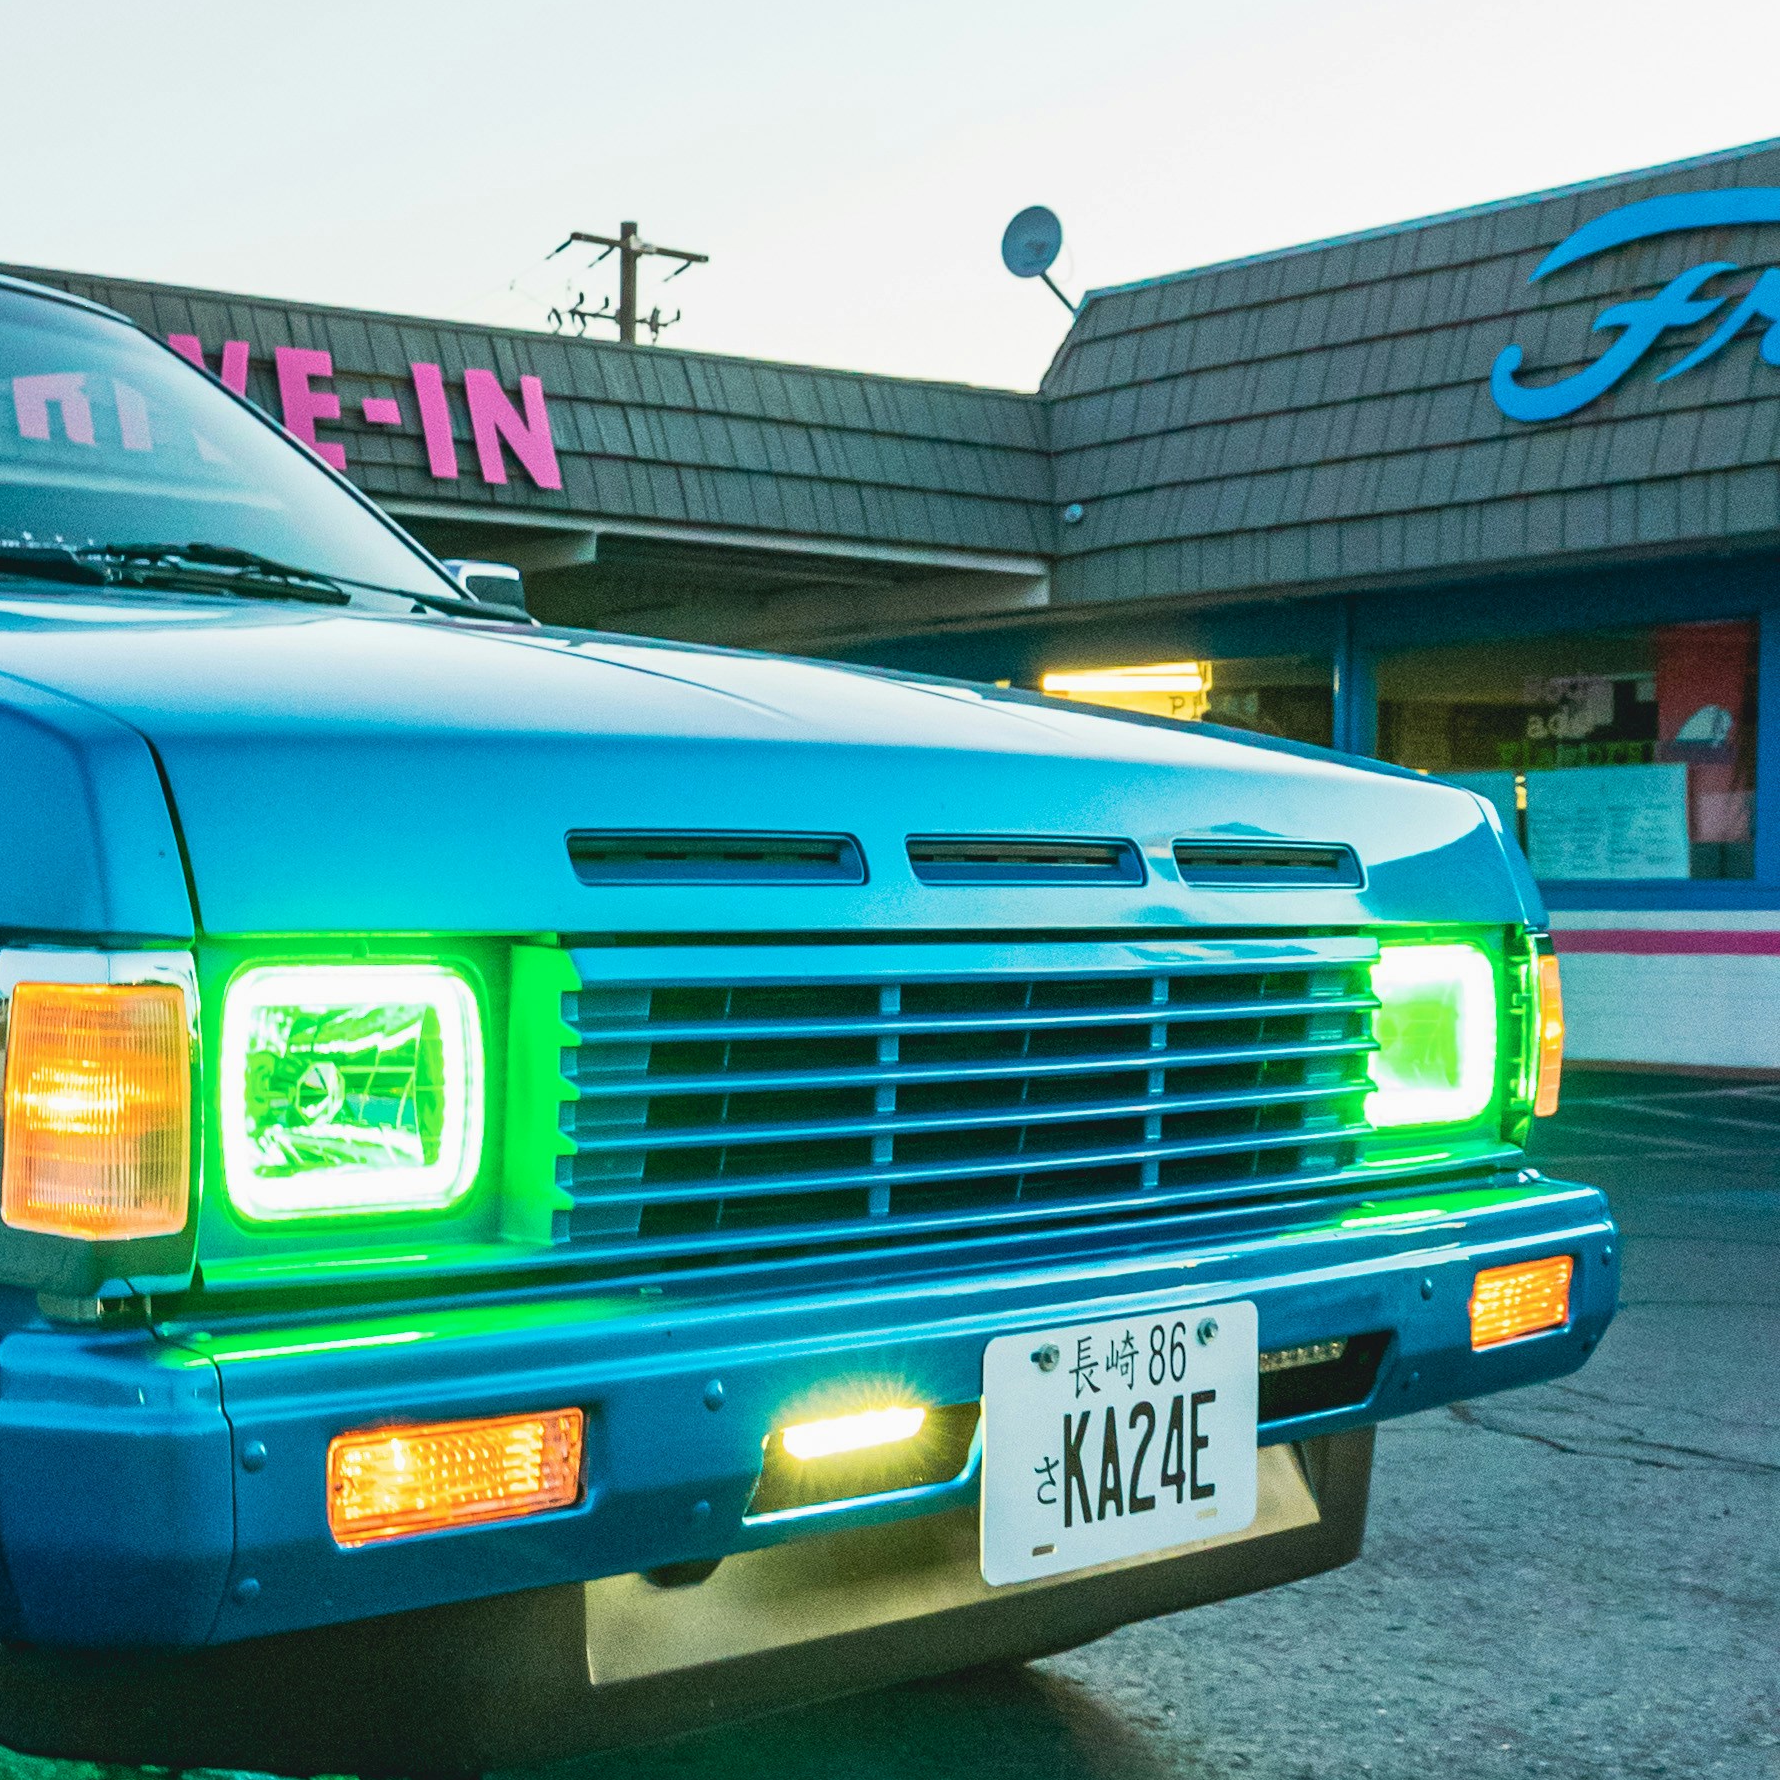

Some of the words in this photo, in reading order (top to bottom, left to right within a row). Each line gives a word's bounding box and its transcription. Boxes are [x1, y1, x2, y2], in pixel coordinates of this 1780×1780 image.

[1068, 1329, 1140, 1399] 長崎
[1148, 1321, 1187, 1386] 86
[1034, 1456, 1060, 1505] さ
[1063, 1389, 1217, 1528] KA24E
